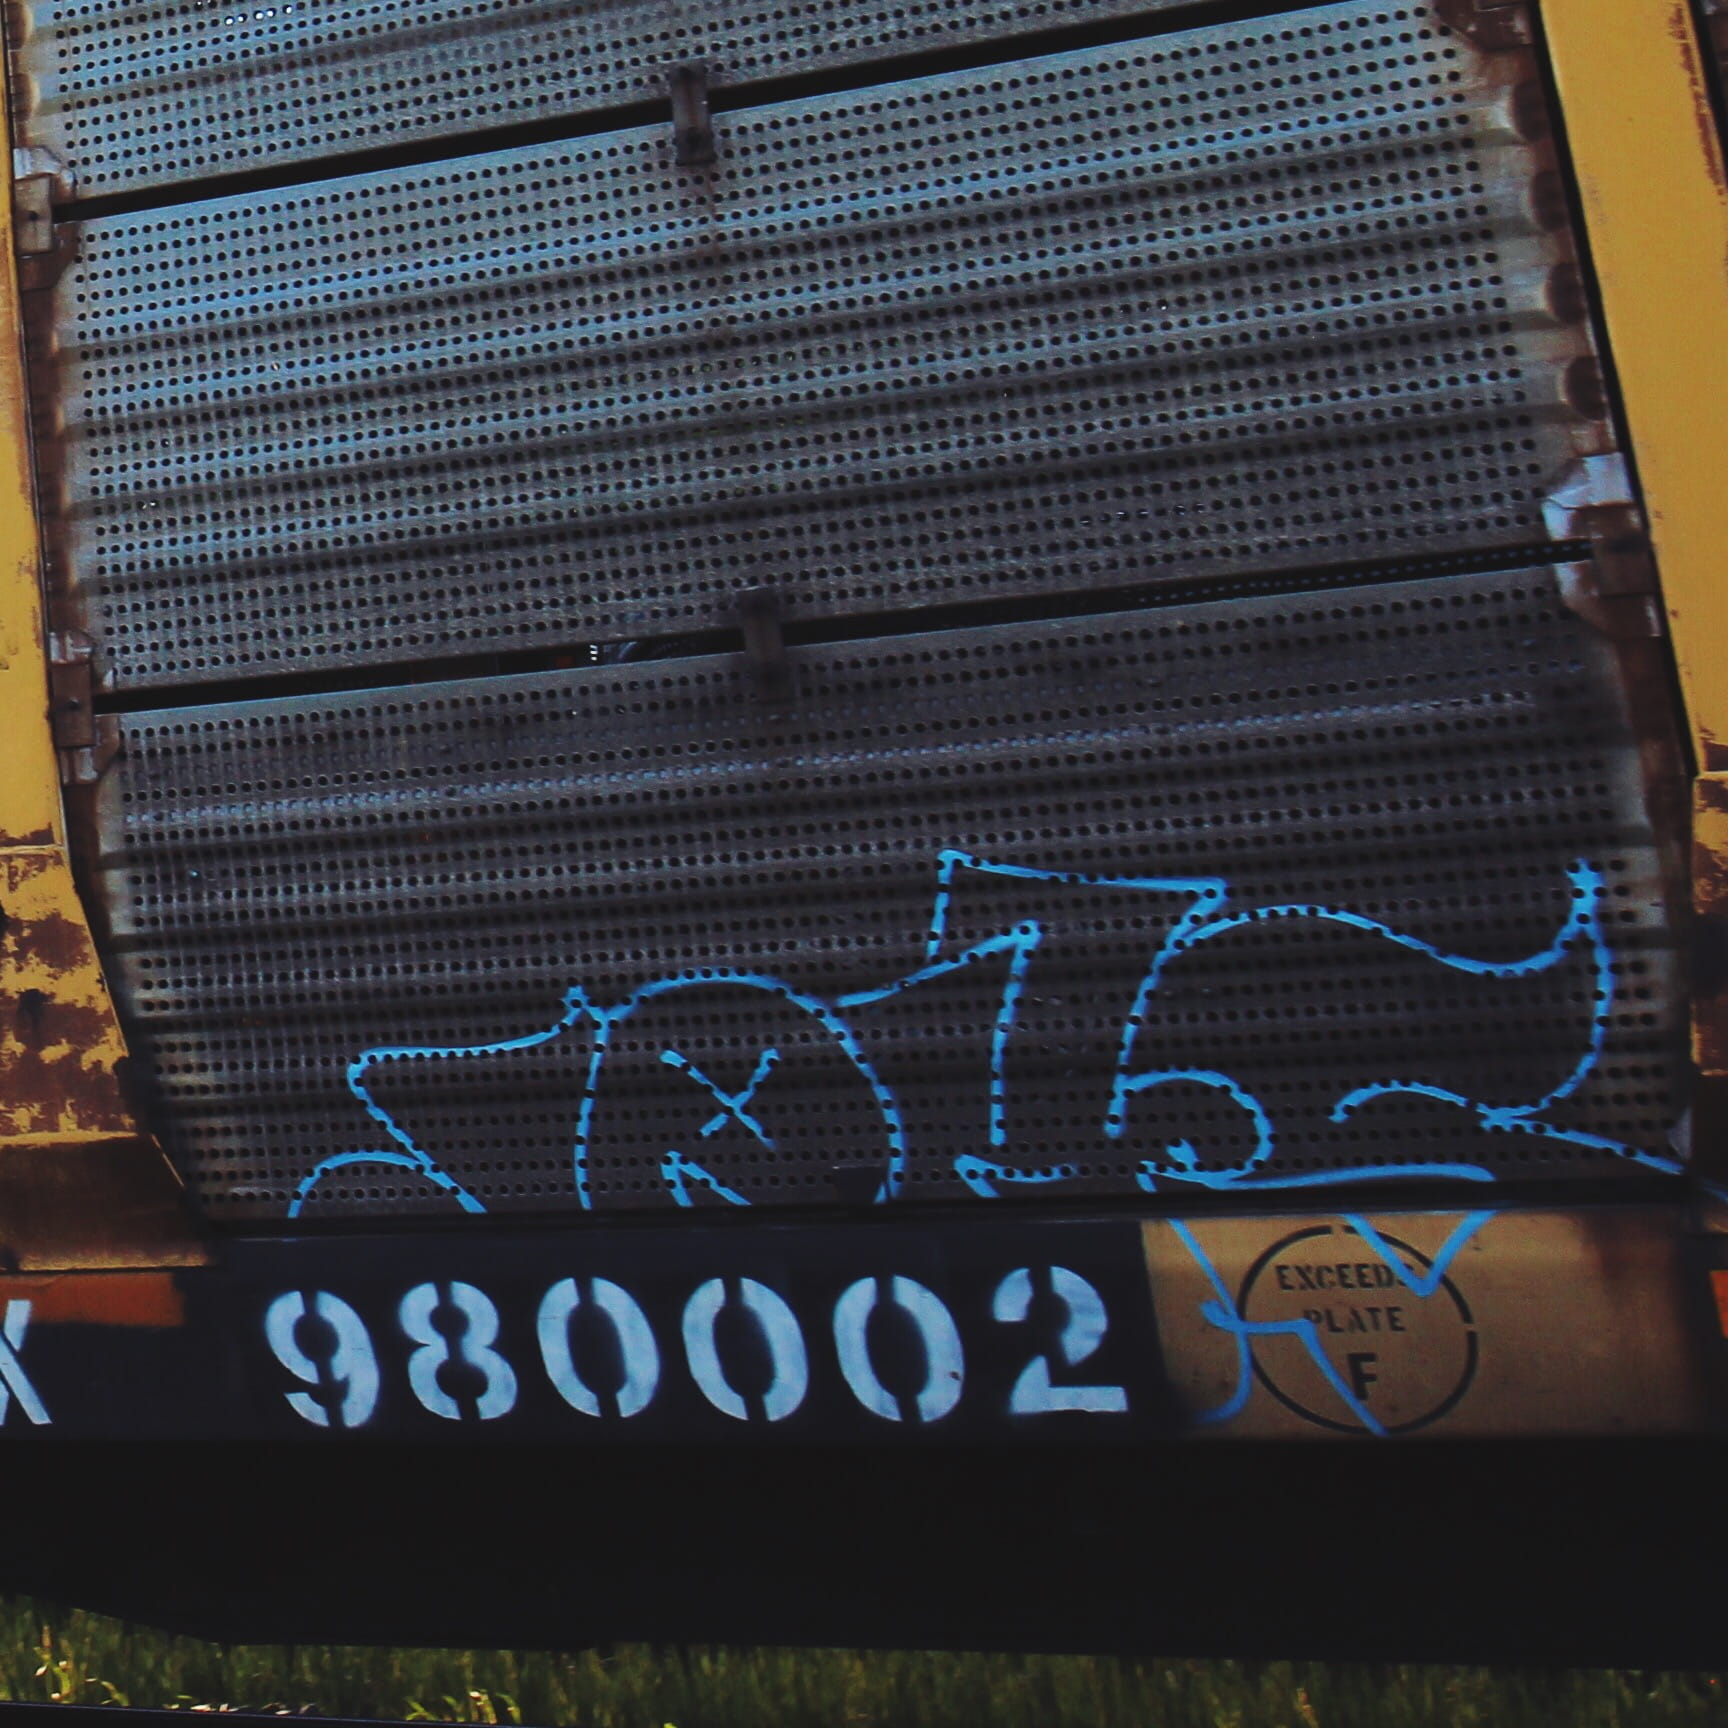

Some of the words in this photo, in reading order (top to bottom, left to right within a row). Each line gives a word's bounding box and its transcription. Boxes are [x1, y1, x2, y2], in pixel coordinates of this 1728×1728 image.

[1304, 1305, 1407, 1334] PLATE
[263, 1265, 1129, 1430] 980002
[1346, 1351, 1378, 1400] F
